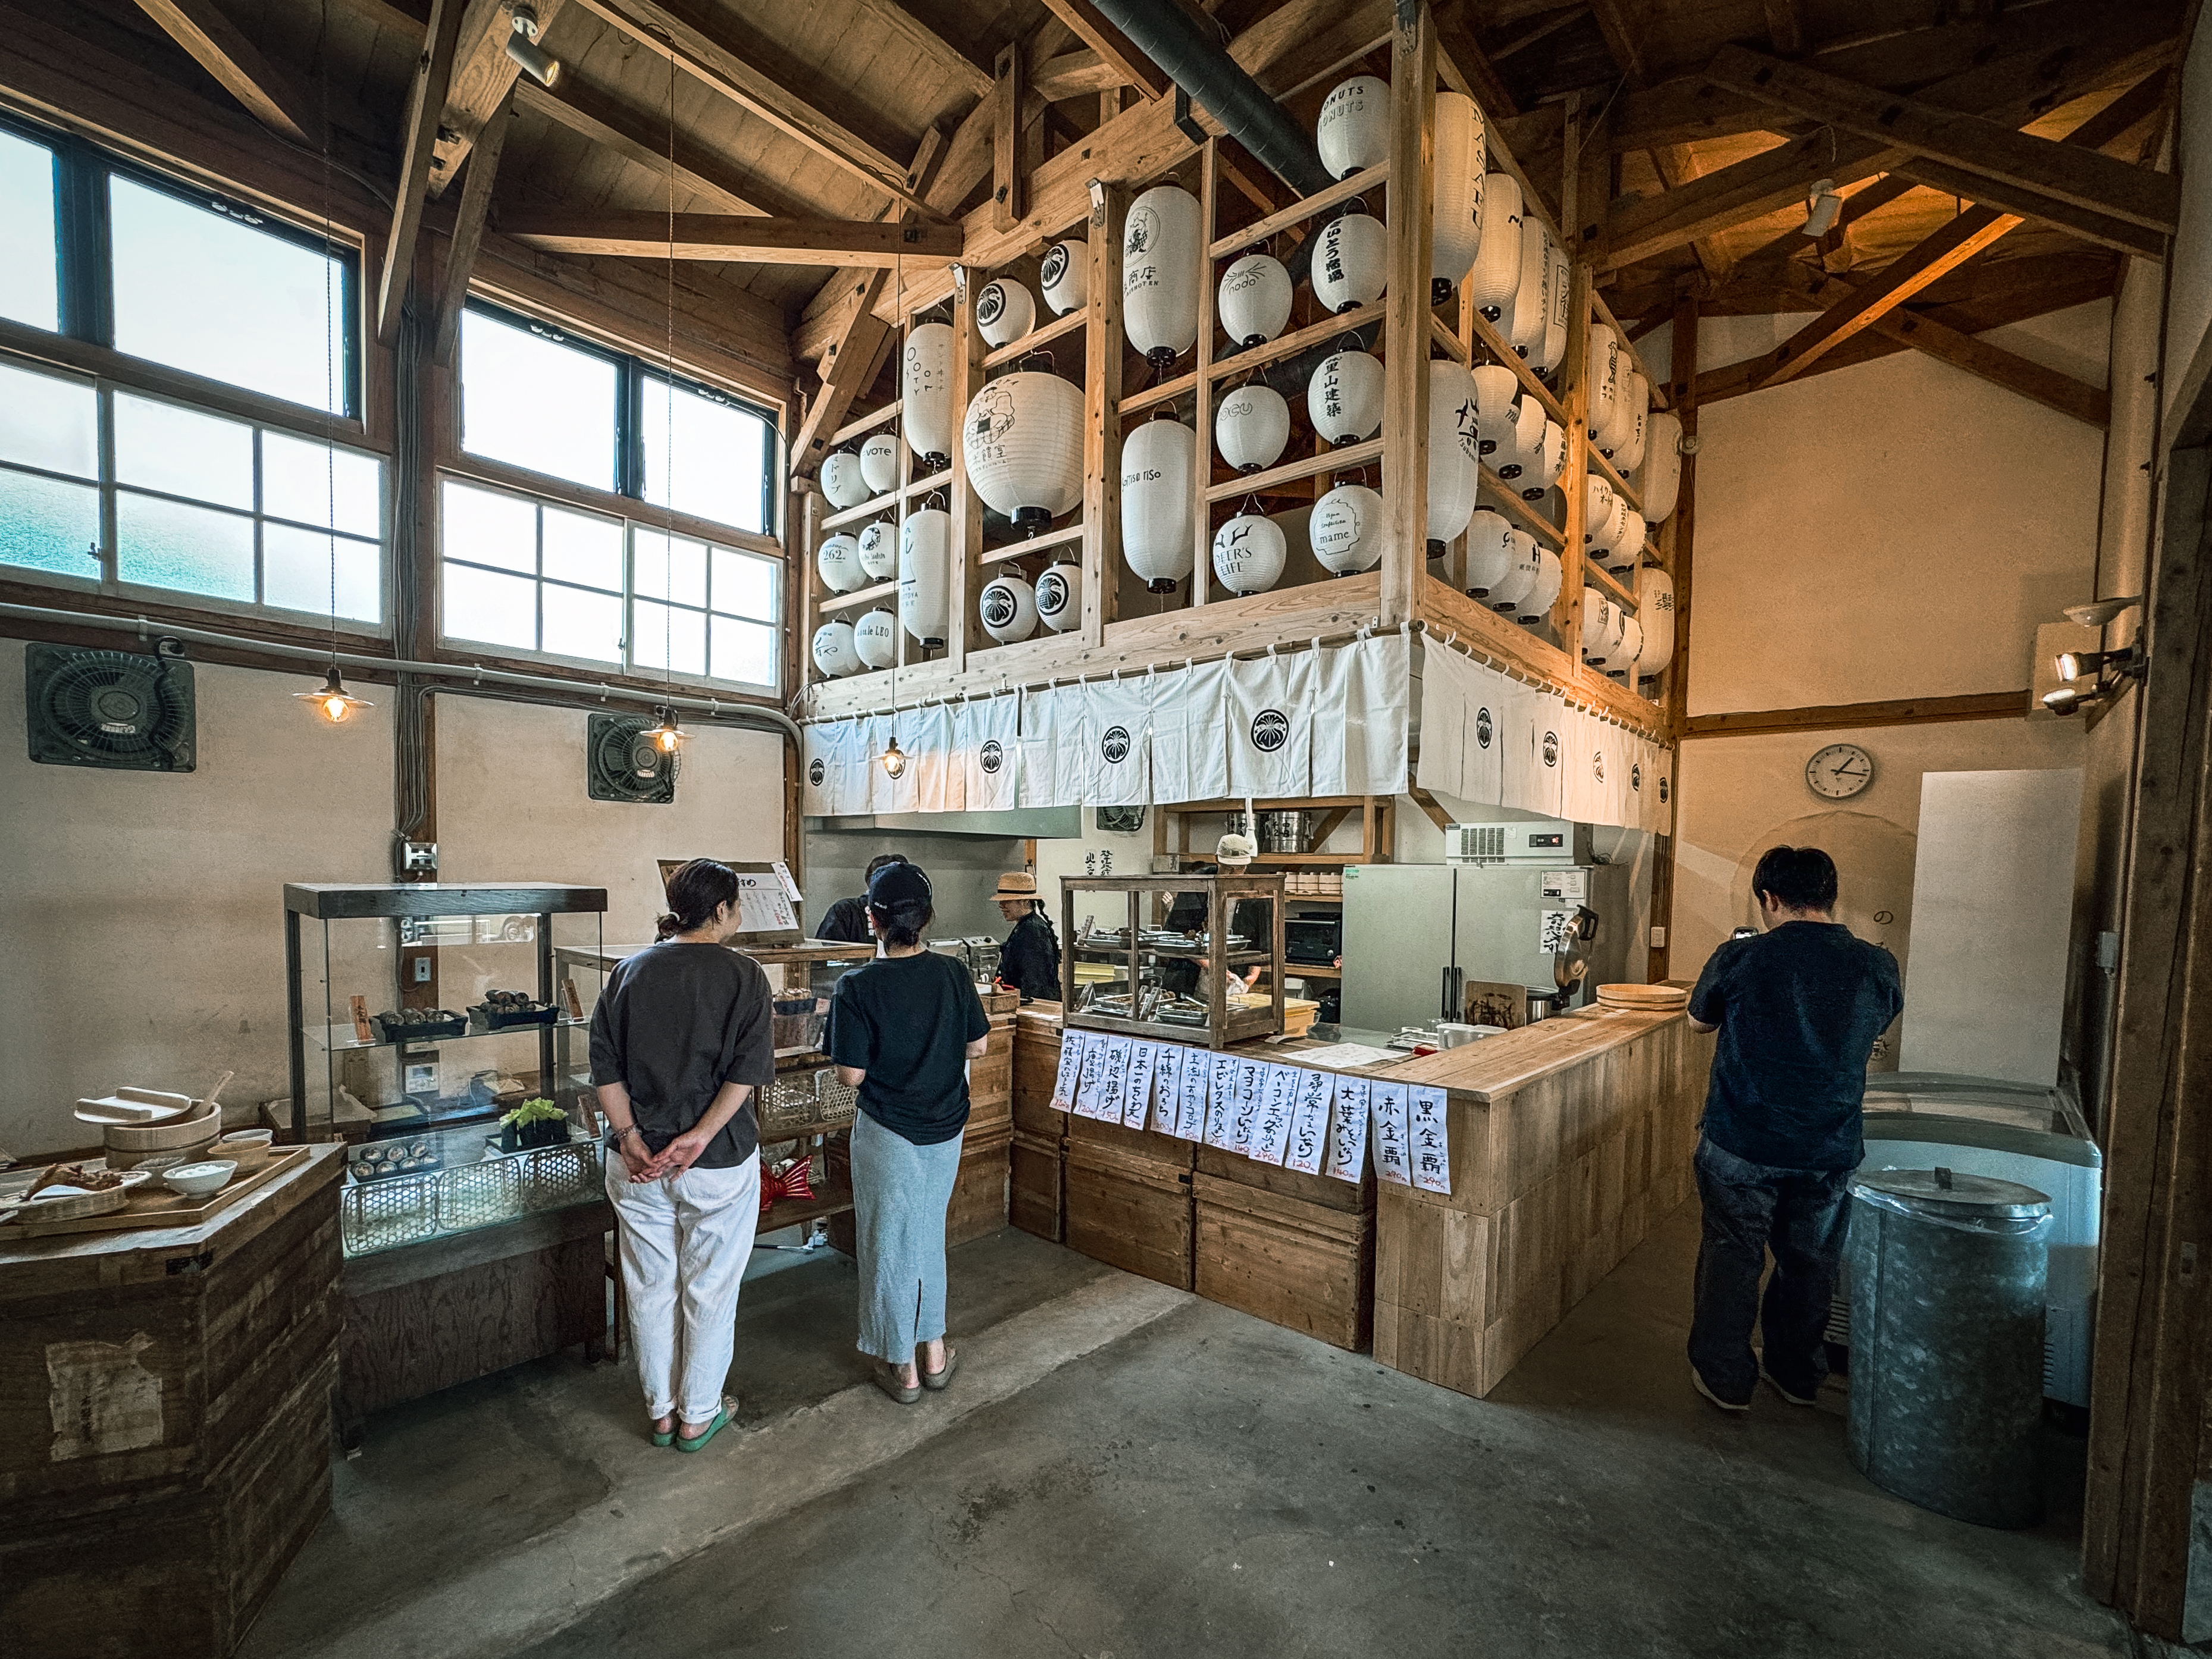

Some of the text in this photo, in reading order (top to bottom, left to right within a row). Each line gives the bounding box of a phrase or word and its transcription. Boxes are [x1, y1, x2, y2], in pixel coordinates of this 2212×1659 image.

[1320, 86, 1364, 115] ONUTS
[1320, 532, 1349, 544] mame
[875, 626, 889, 637] LEO
[1126, 1047, 1148, 1119] 日本一のちくわ天
[1416, 1100, 1440, 1175] 黒金覇
